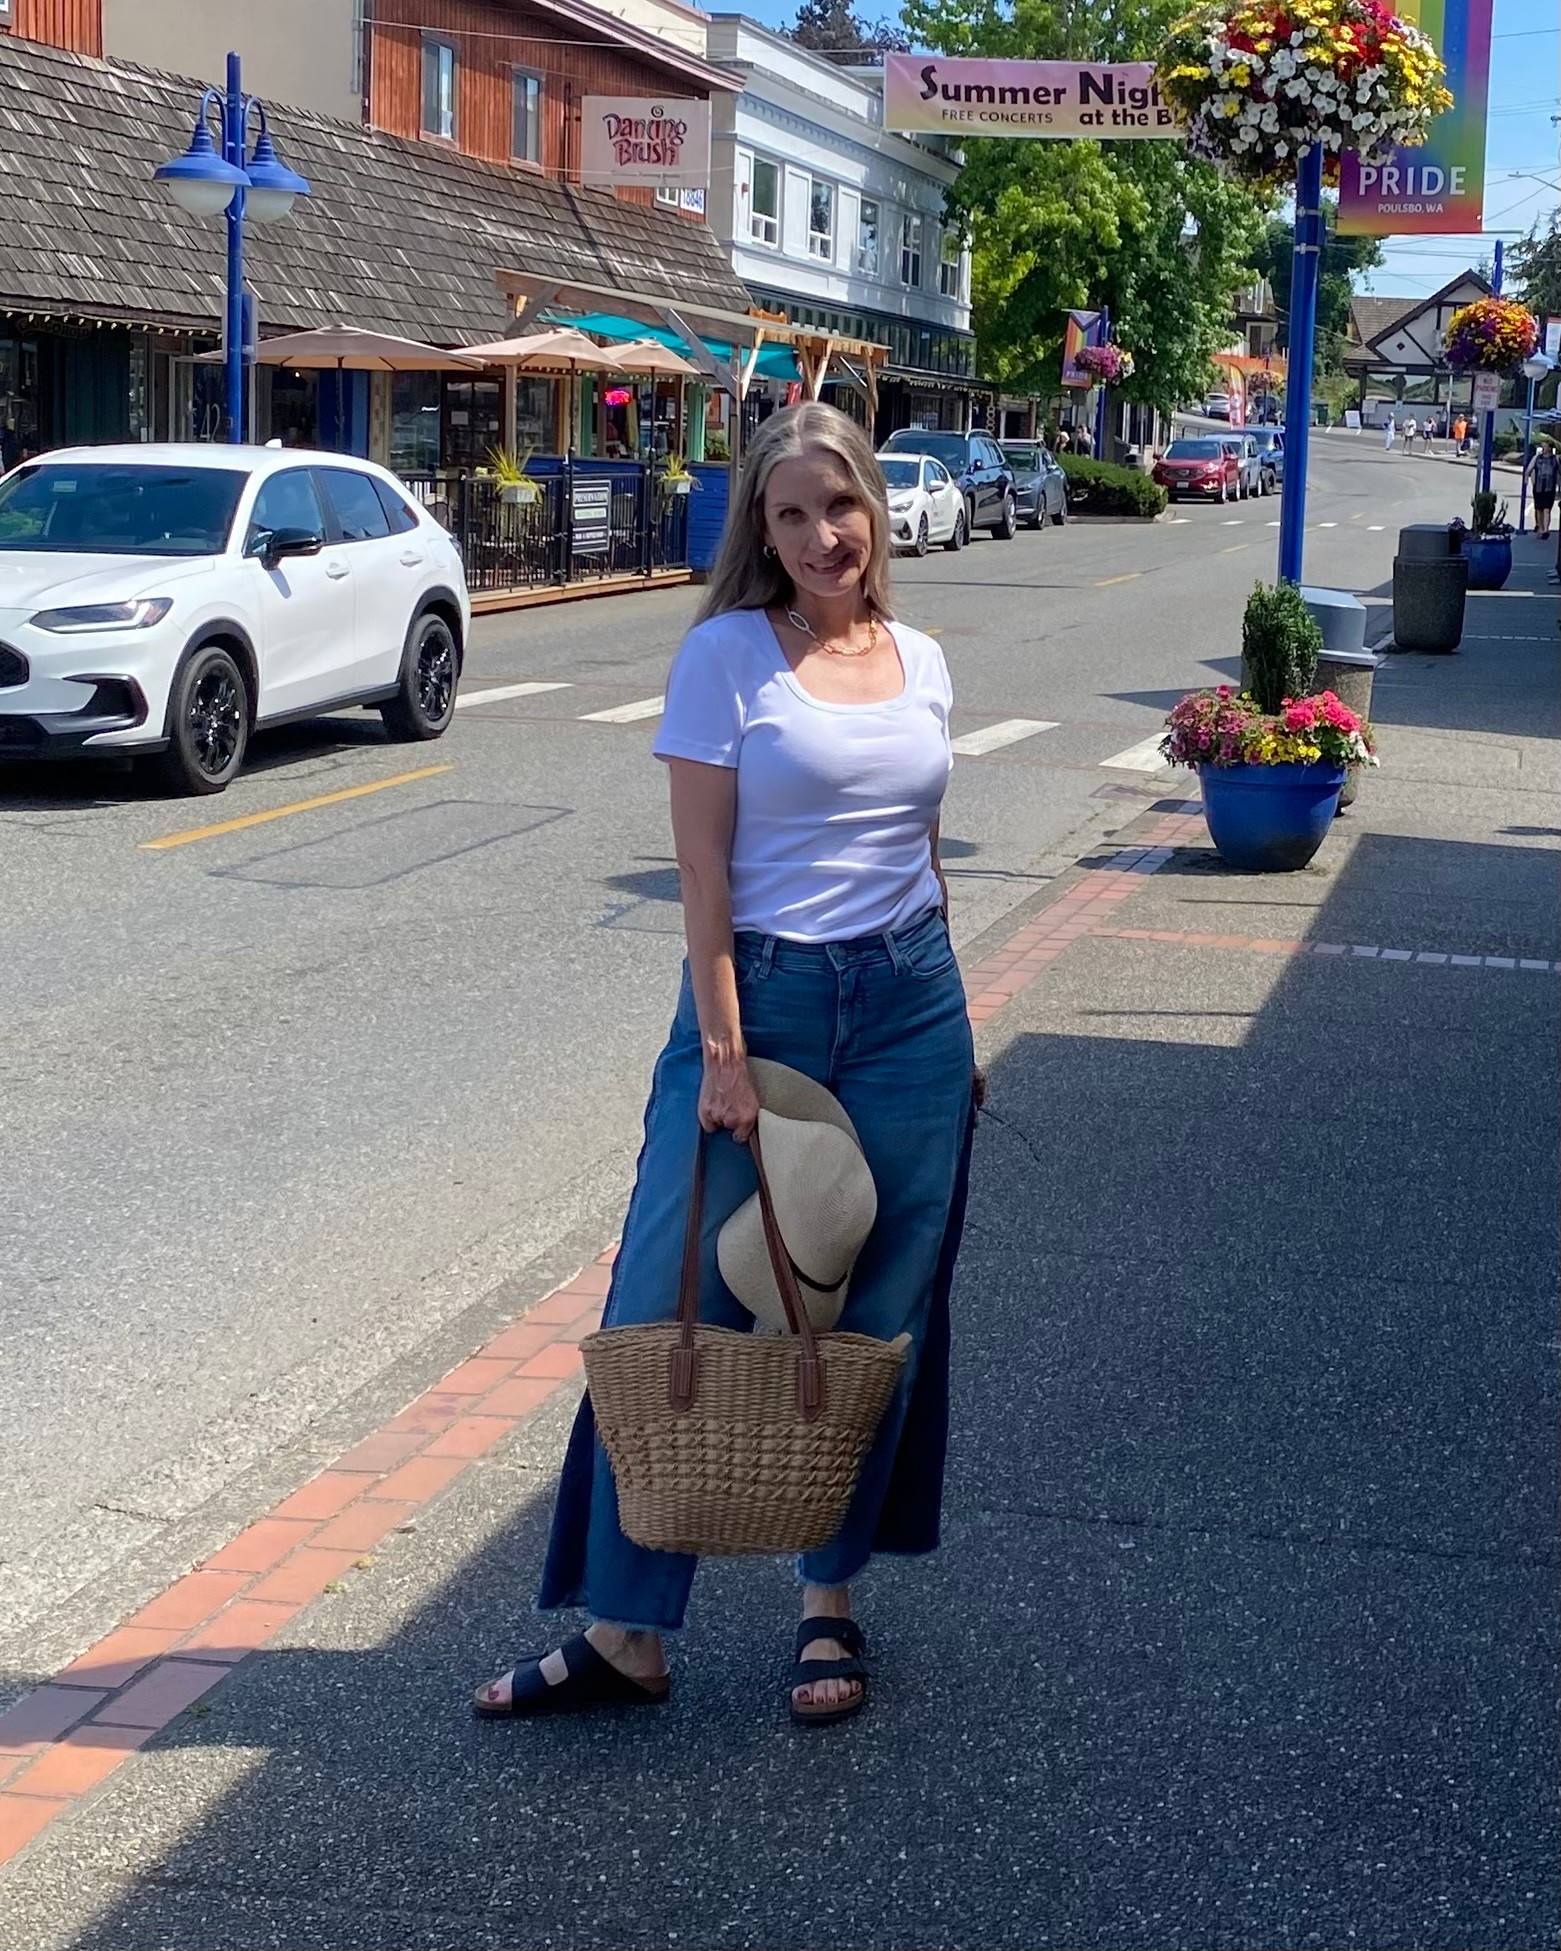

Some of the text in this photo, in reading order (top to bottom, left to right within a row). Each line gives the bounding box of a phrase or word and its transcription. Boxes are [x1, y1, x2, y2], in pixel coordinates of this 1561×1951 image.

[920, 64, 1067, 105] Summer
[602, 105, 688, 146] Dancing
[942, 108, 1053, 124] FREE CONCERTS
[1079, 109, 1104, 126] at
[1111, 108, 1149, 126] the
[613, 138, 677, 166] Brush
[1358, 166, 1467, 196] PRIDE
[1378, 203, 1444, 213] POULSBO, WA
